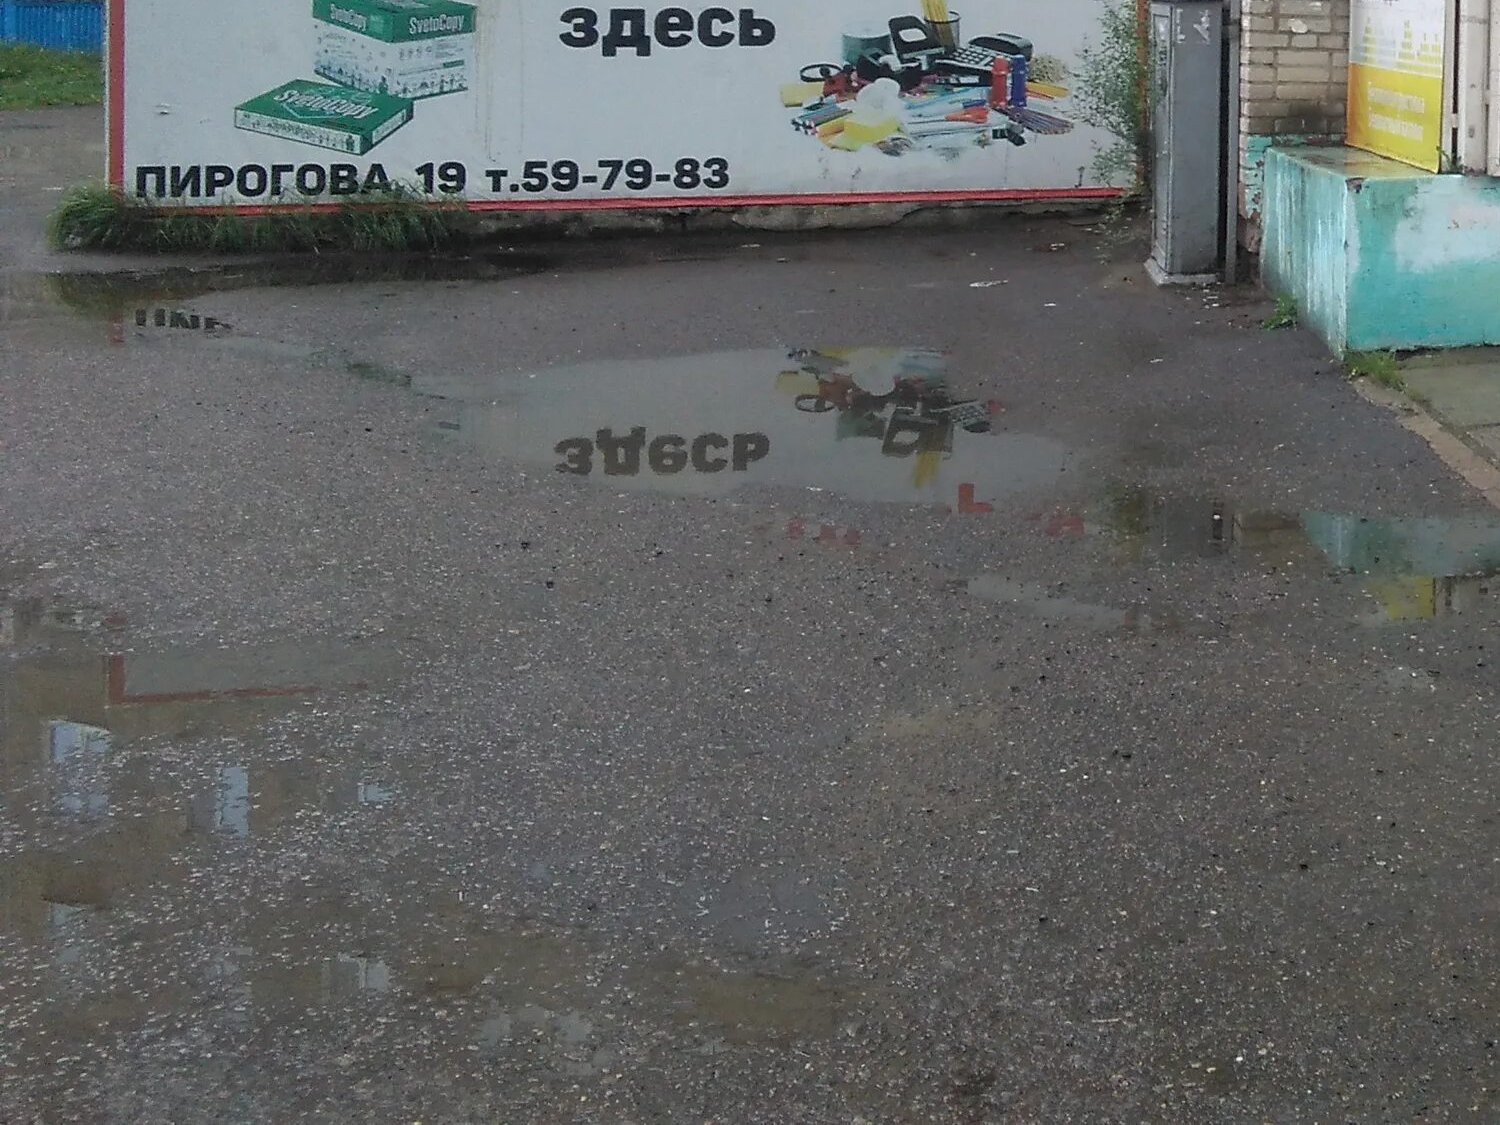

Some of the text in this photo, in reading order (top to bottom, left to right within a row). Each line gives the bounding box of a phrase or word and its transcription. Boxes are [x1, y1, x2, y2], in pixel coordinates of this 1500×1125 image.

[559, 4, 776, 57] здесь
[136, 158, 730, 197] ПИРОГОВА 19 т.59-79-83
